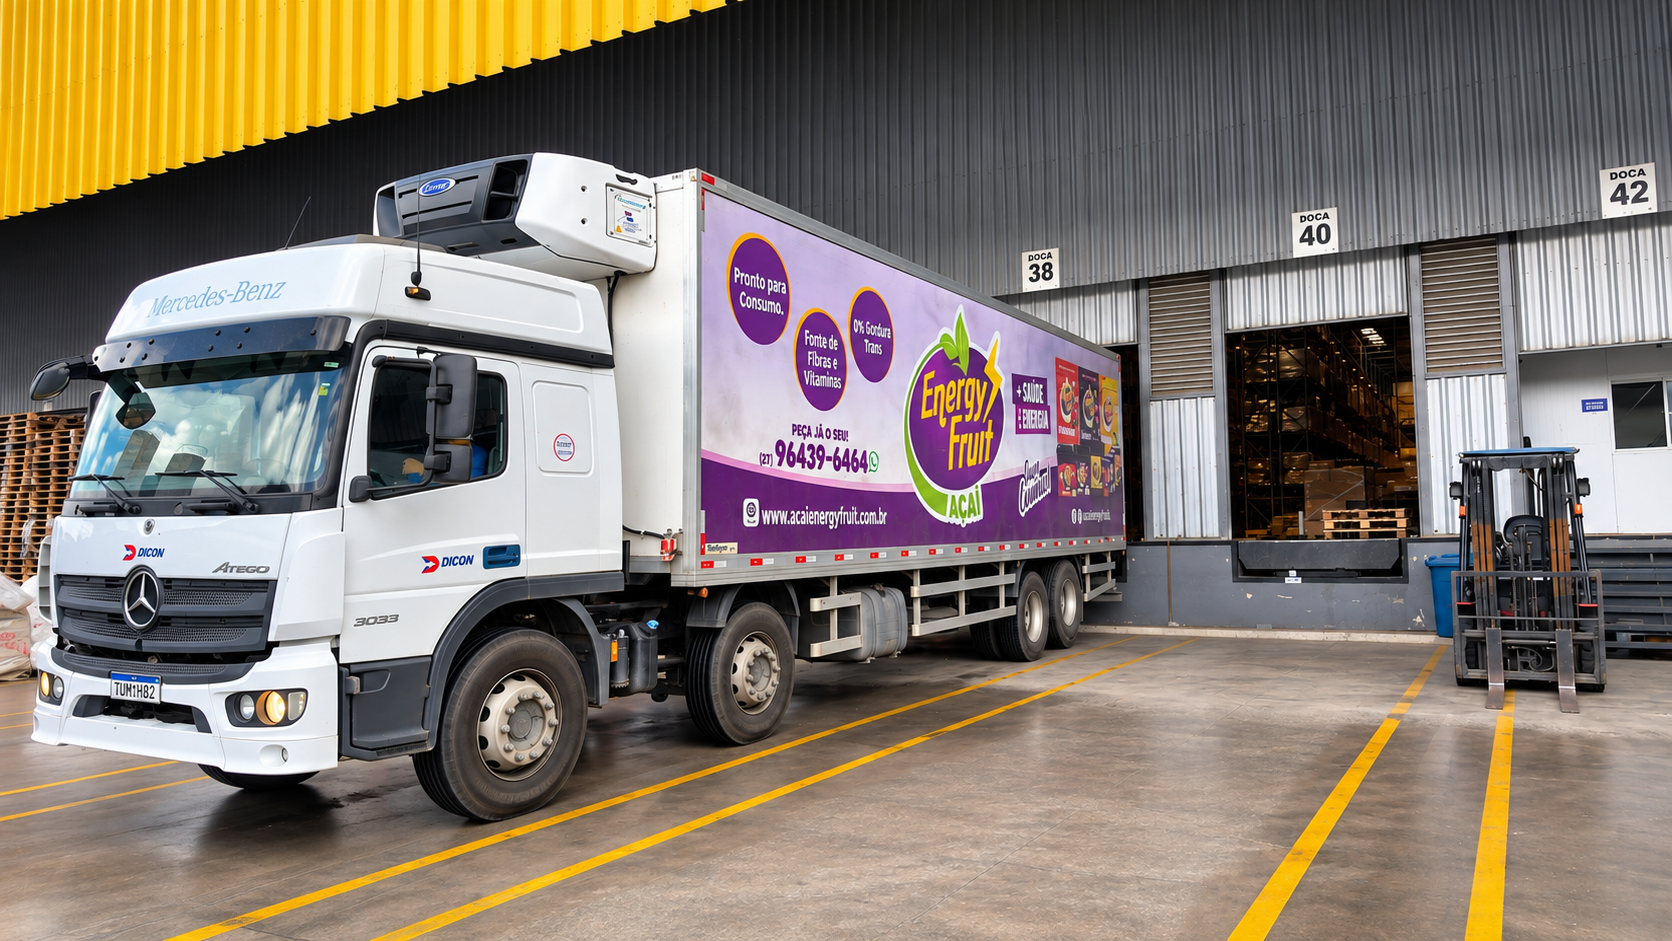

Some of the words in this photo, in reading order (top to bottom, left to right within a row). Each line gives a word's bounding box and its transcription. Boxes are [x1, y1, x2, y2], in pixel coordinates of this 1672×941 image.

[1610, 168, 1647, 180] DOCA
[1609, 180, 1649, 206] 42
[1299, 212, 1331, 223] DOCA
[1298, 223, 1332, 246] 40
[1028, 251, 1053, 262] DOCA
[734, 267, 766, 291] Pronto
[767, 279, 787, 296] para
[1028, 262, 1054, 283] 38
[147, 281, 287, 318] Mercedes-Benz
[739, 291, 785, 316] Consumo.
[853, 318, 865, 335] 0%
[865, 319, 892, 339] Gordura
[804, 329, 828, 350] Fonte
[828, 334, 839, 351] de
[863, 338, 883, 356] Trans
[807, 350, 832, 370] Fibras
[832, 357, 838, 370] e
[803, 370, 842, 390] Vitaminas
[920, 369, 988, 428] Energy
[1022, 379, 1045, 404] SAÚDE
[791, 423, 812, 440] PEÇA
[813, 423, 825, 440] JÁ
[825, 427, 832, 440] O
[832, 428, 849, 442] SEU!
[947, 414, 994, 471] Fruit
[759, 452, 774, 467] (27)
[775, 439, 869, 474] 96439-6464
[948, 484, 981, 525] AÇAÍ
[761, 506, 888, 530] www.acaienergyfruit.com.br
[137, 547, 166, 558] DICON
[440, 554, 475, 568] DICON
[211, 561, 271, 574] ATEGO
[353, 614, 400, 628] 3033
